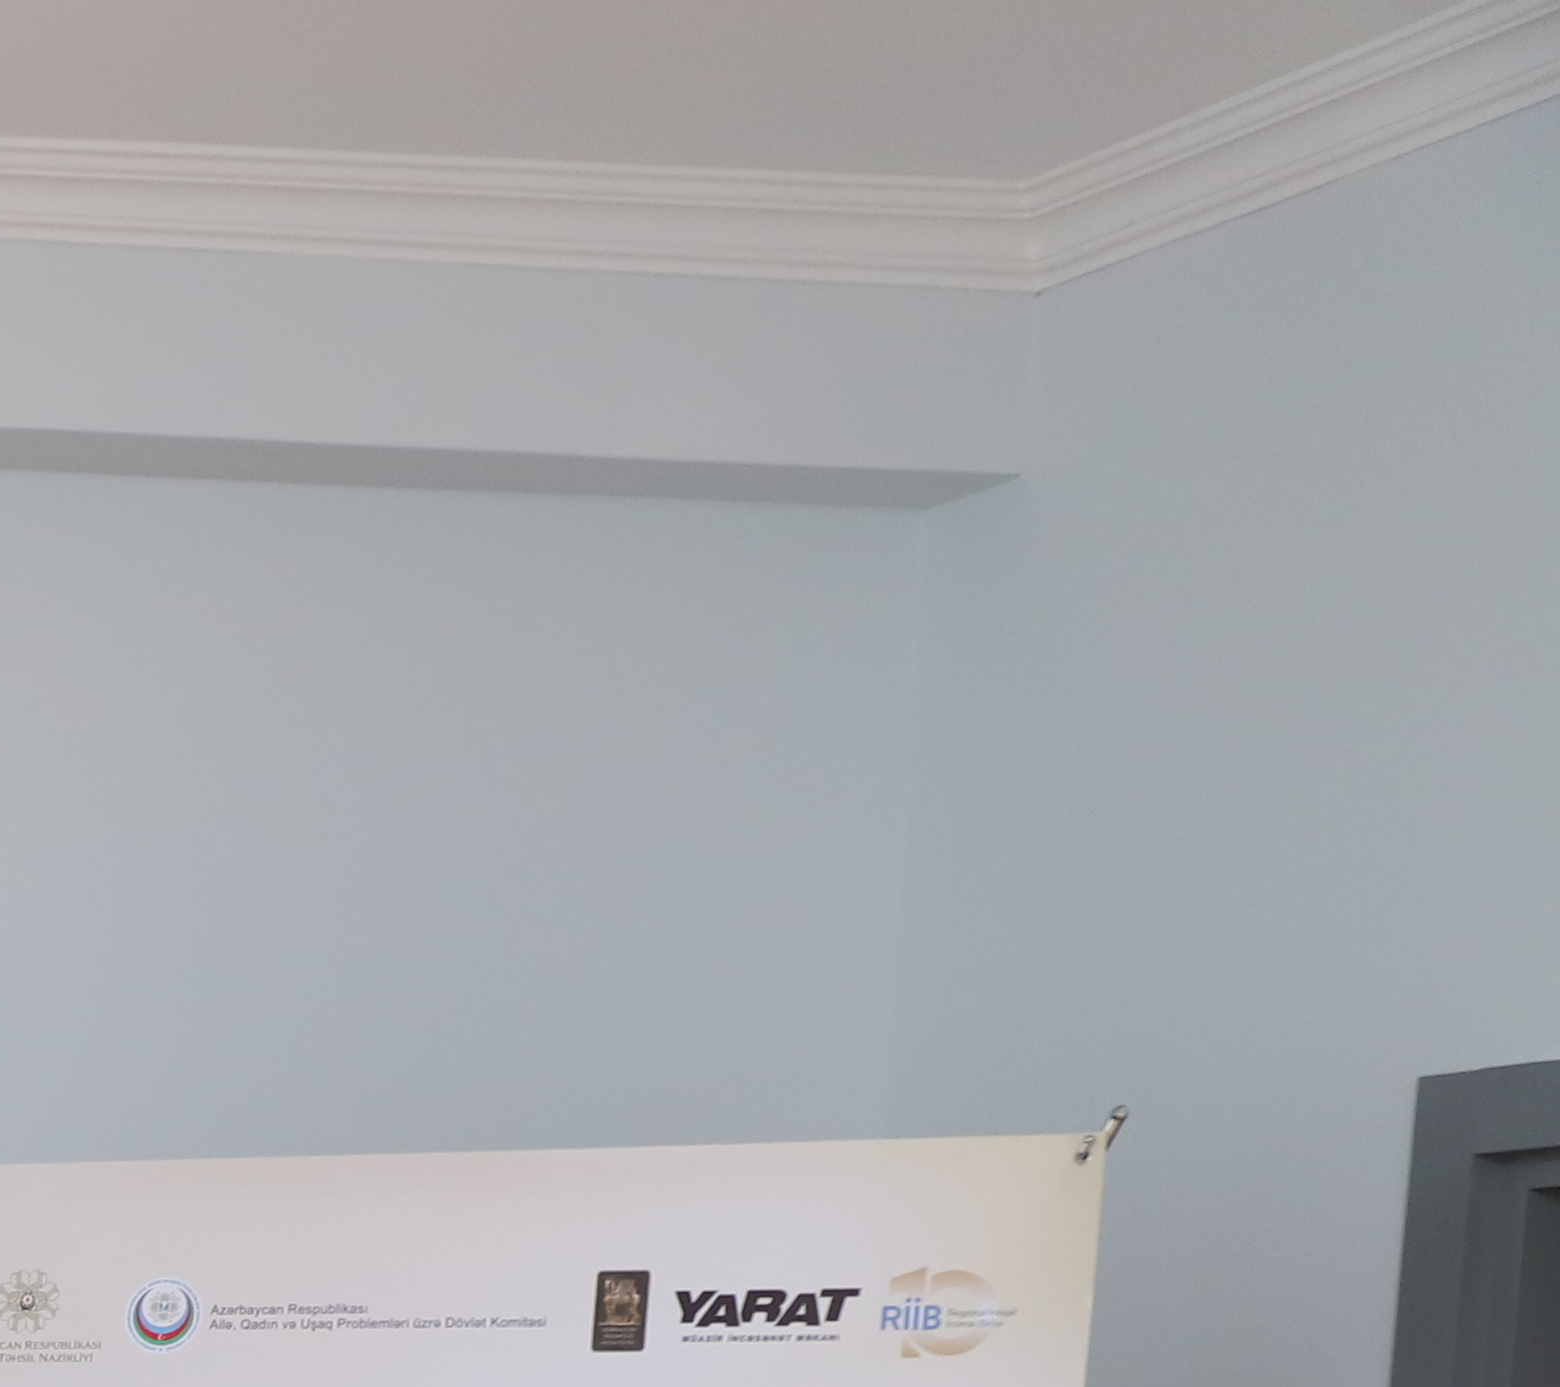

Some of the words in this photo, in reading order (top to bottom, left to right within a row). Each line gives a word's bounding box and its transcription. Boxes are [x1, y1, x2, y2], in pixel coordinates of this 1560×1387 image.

[211, 1305, 284, 1317] Azərbaycan
[288, 1304, 368, 1316] Respublikası
[675, 1288, 861, 1327] YARAT
[241, 1319, 278, 1330] Qadın
[282, 1321, 296, 1329] və
[301, 1319, 333, 1331] Uşaq
[25, 1340, 102, 1349] RESPUBLİKASI
